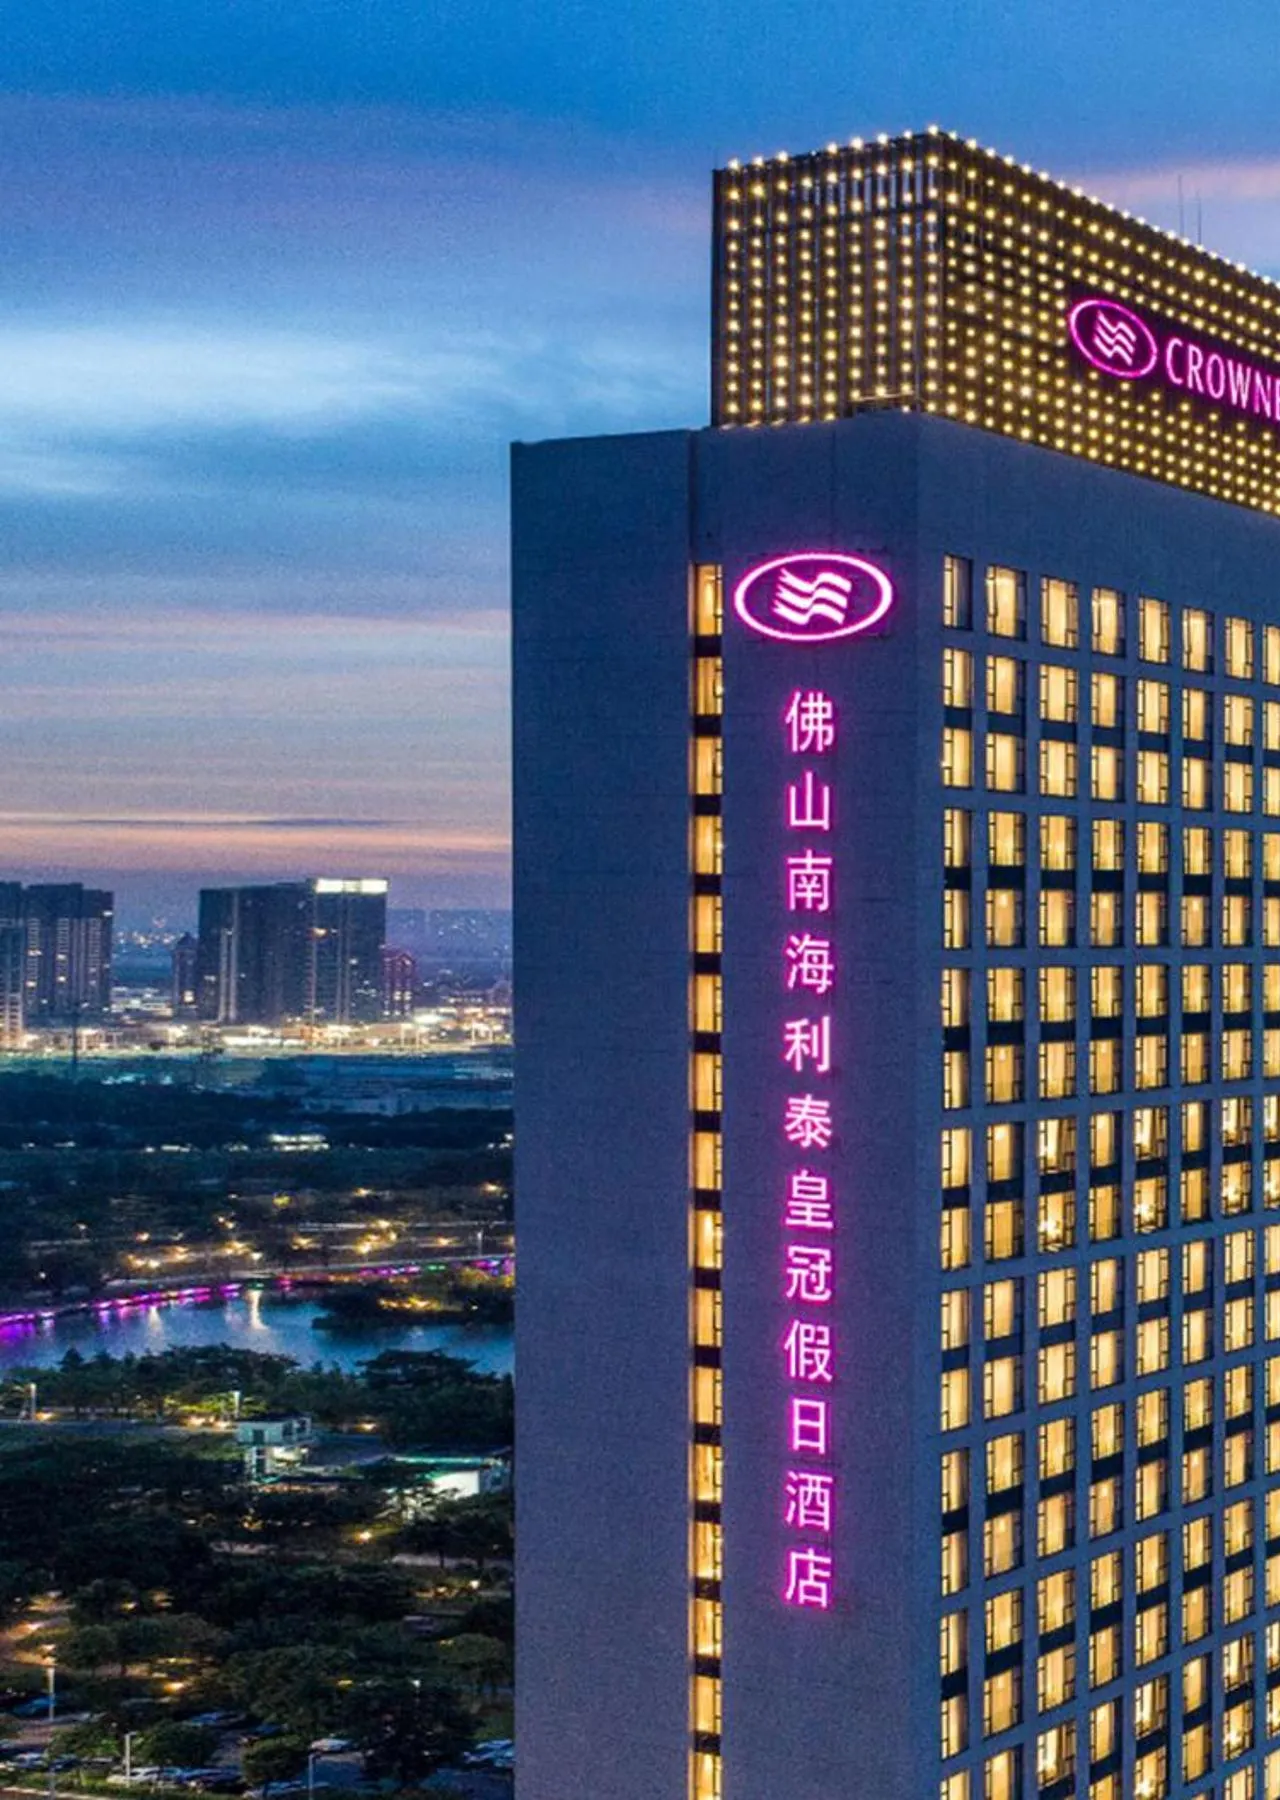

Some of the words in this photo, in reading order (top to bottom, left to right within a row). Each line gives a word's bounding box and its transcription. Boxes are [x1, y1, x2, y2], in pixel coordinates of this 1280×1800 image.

[784, 690, 835, 1610] 佛山南海利泰皇冠假日酒店
